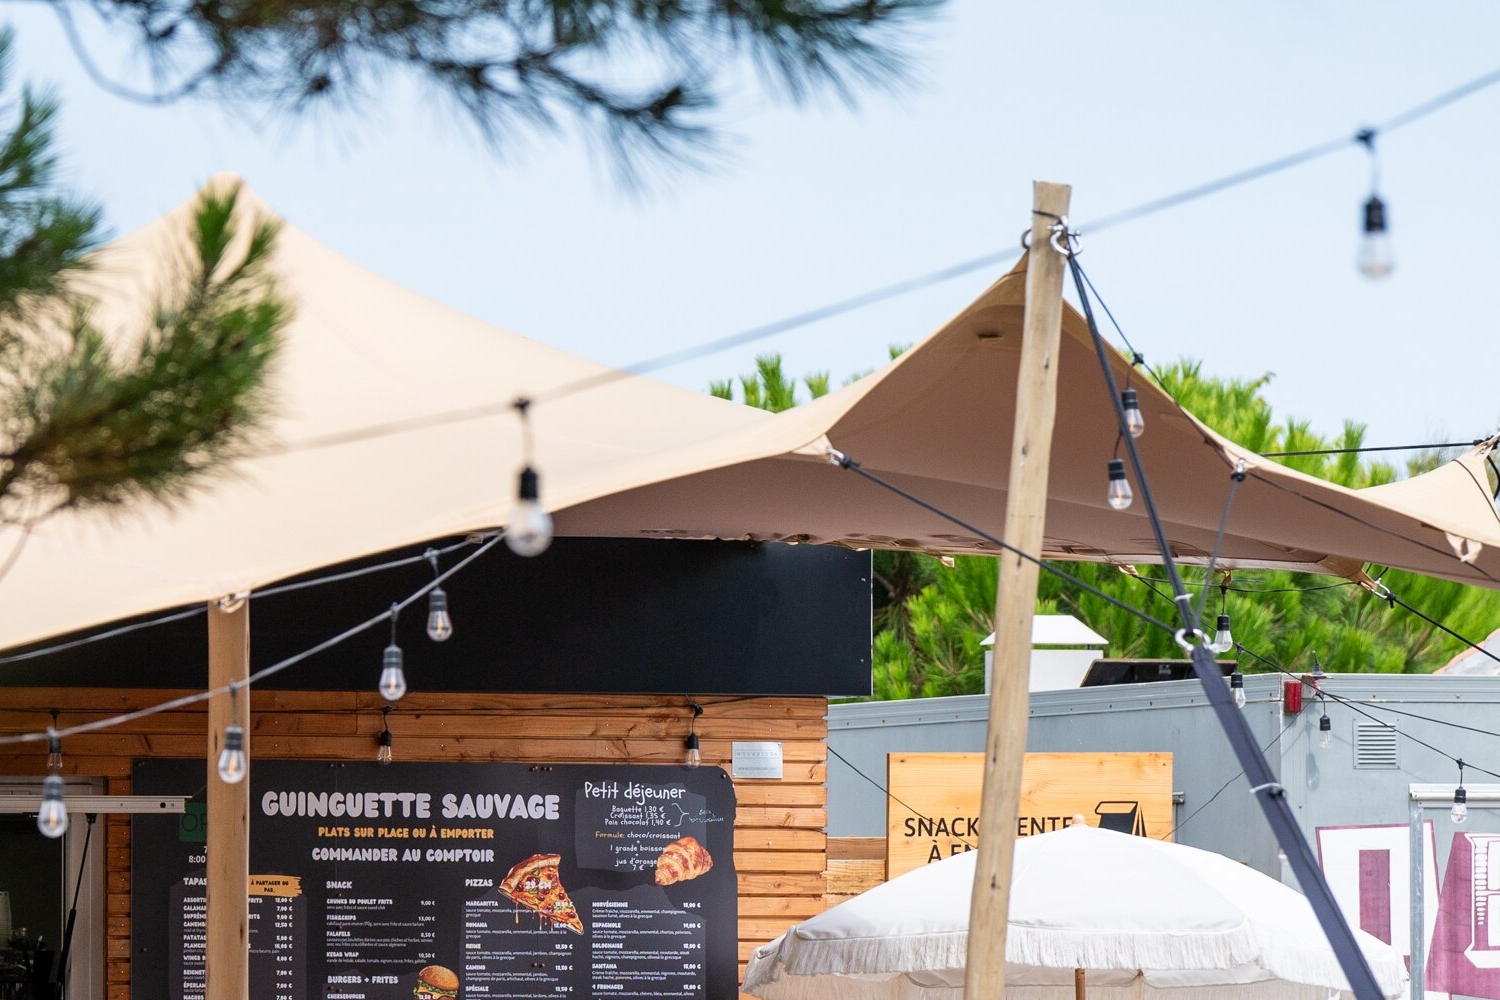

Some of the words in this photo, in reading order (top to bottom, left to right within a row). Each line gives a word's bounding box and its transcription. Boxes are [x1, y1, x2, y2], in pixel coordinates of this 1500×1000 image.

[584, 781, 619, 799] Petit
[624, 782, 686, 806] déjeuner
[261, 790, 431, 819] GUINGUETTE
[441, 793, 560, 820] SAUVAGE
[612, 805, 642, 814] Baguette
[610, 812, 643, 820] Croissant
[620, 818, 649, 826] chocolat
[318, 826, 351, 838] PLATS
[354, 827, 375, 838] SUR
[377, 827, 409, 839] PLACE
[412, 828, 427, 839] OU
[429, 824, 437, 839] À
[441, 828, 495, 839] EMPORTER
[905, 817, 980, 837] SNACK
[1017, 817, 1073, 837] ENTE
[595, 831, 625, 839] Formule:
[627, 831, 681, 840] choco/croissant
[615, 845, 638, 854] grande
[928, 839, 942, 863] À
[312, 847, 398, 862] COMMANDER
[402, 848, 421, 862] AU
[426, 848, 495, 863] COMPTOIR
[615, 858, 627, 867] jus
[629, 857, 657, 867] d'orange
[183, 877, 208, 886] TAPAS
[326, 881, 352, 889] SNACK
[465, 879, 493, 887] PIZZAS
[327, 976, 362, 984] BURGERS
[372, 976, 399, 984] FRITES
